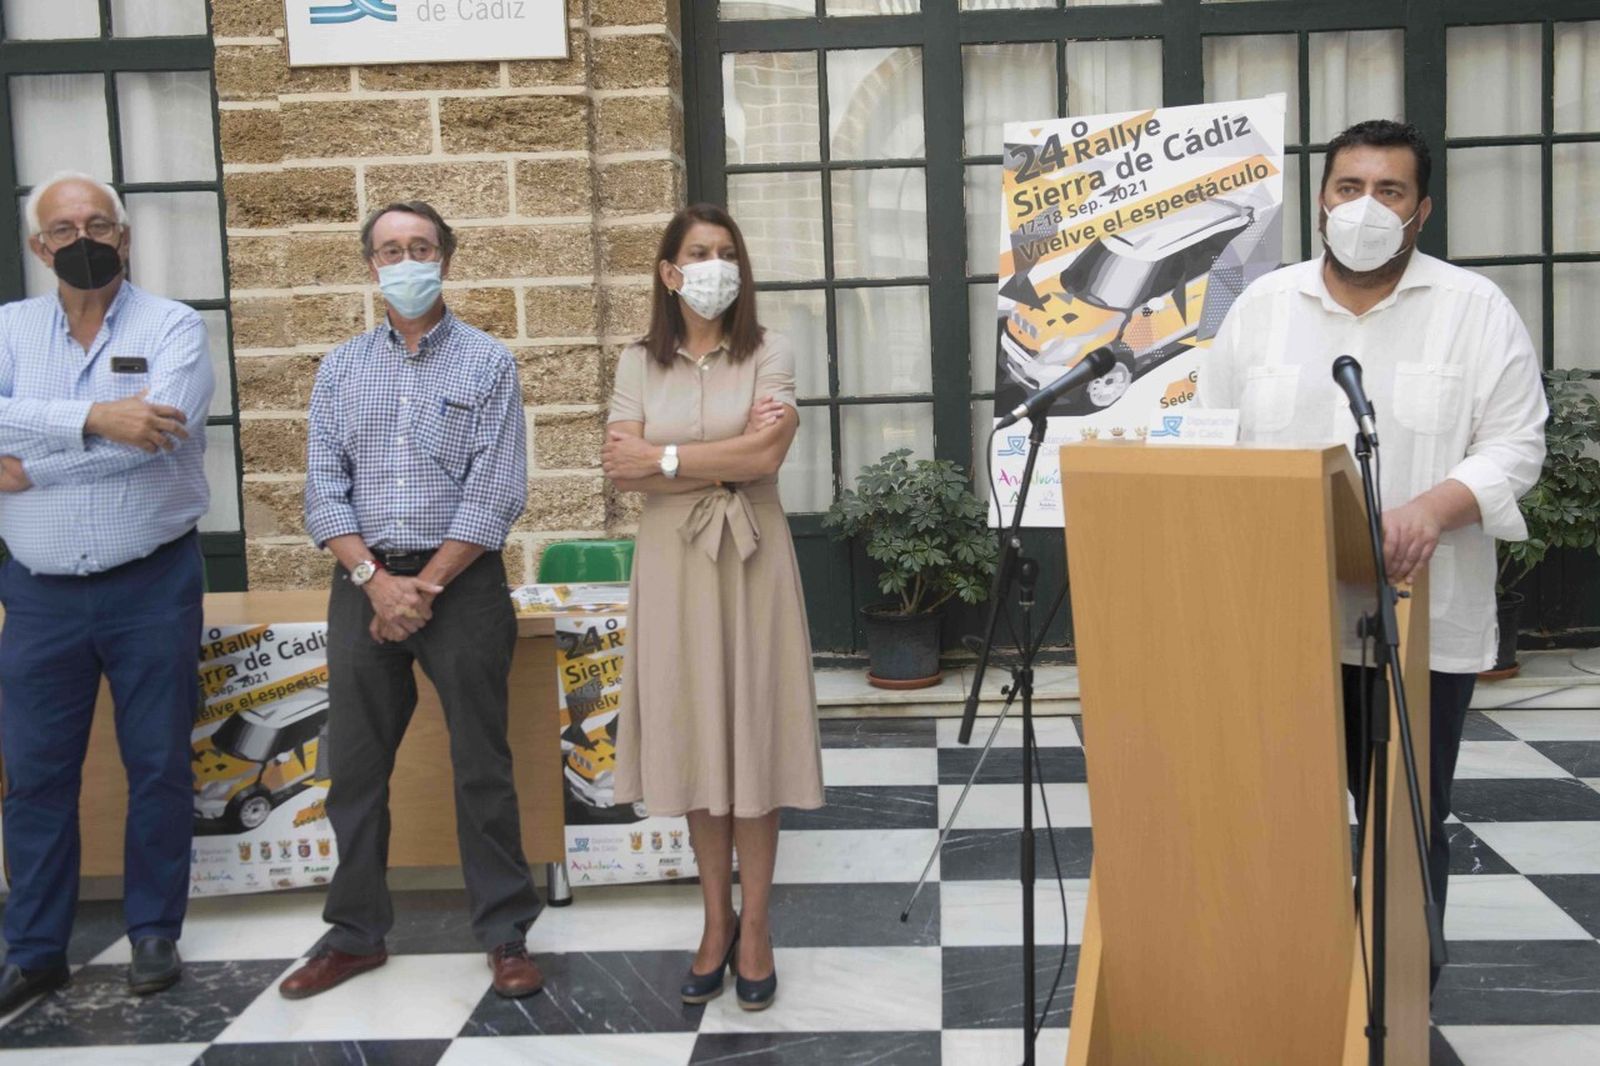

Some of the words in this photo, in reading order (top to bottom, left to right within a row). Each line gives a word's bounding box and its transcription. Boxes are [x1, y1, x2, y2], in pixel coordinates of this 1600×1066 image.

[417, 0, 446, 21] de
[1073, 118, 1161, 163] Rallye
[1013, 170, 1106, 217] Sierra
[1116, 152, 1153, 180] de
[1163, 115, 1250, 161] Cádiz
[1019, 211, 1064, 235] 17-18
[1067, 199, 1103, 219] Sep.
[1109, 180, 1147, 204] 2021
[1020, 225, 1096, 260] Vuelve
[1103, 210, 1123, 232] el
[1130, 164, 1268, 222] espectáculo
[1160, 391, 1194, 409] Sede
[210, 629, 275, 659] Rallye
[244, 652, 272, 671] de
[277, 630, 328, 660] Cádi
[242, 671, 269, 688] 2021
[565, 655, 624, 685] Sierr
[240, 692, 253, 708] el
[259, 671, 328, 700] espectác
[574, 694, 619, 716] Vuelv
